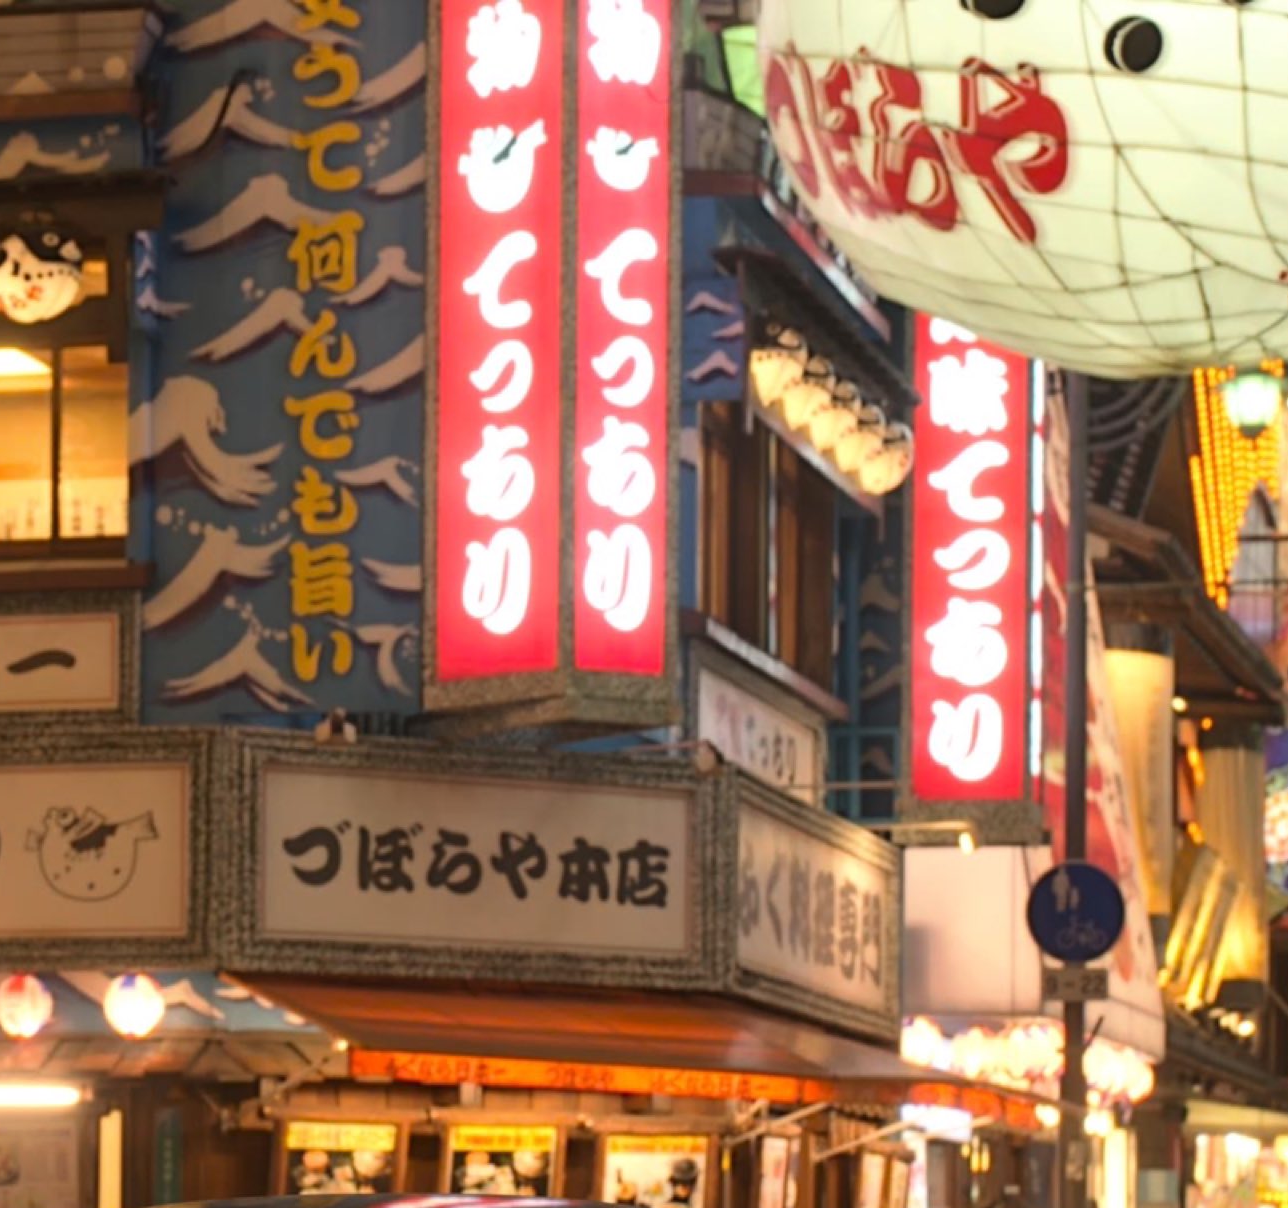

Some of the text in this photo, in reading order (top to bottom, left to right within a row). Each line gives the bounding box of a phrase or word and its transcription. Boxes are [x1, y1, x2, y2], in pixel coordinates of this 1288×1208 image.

[283, 817, 670, 909] づぼらや本店
